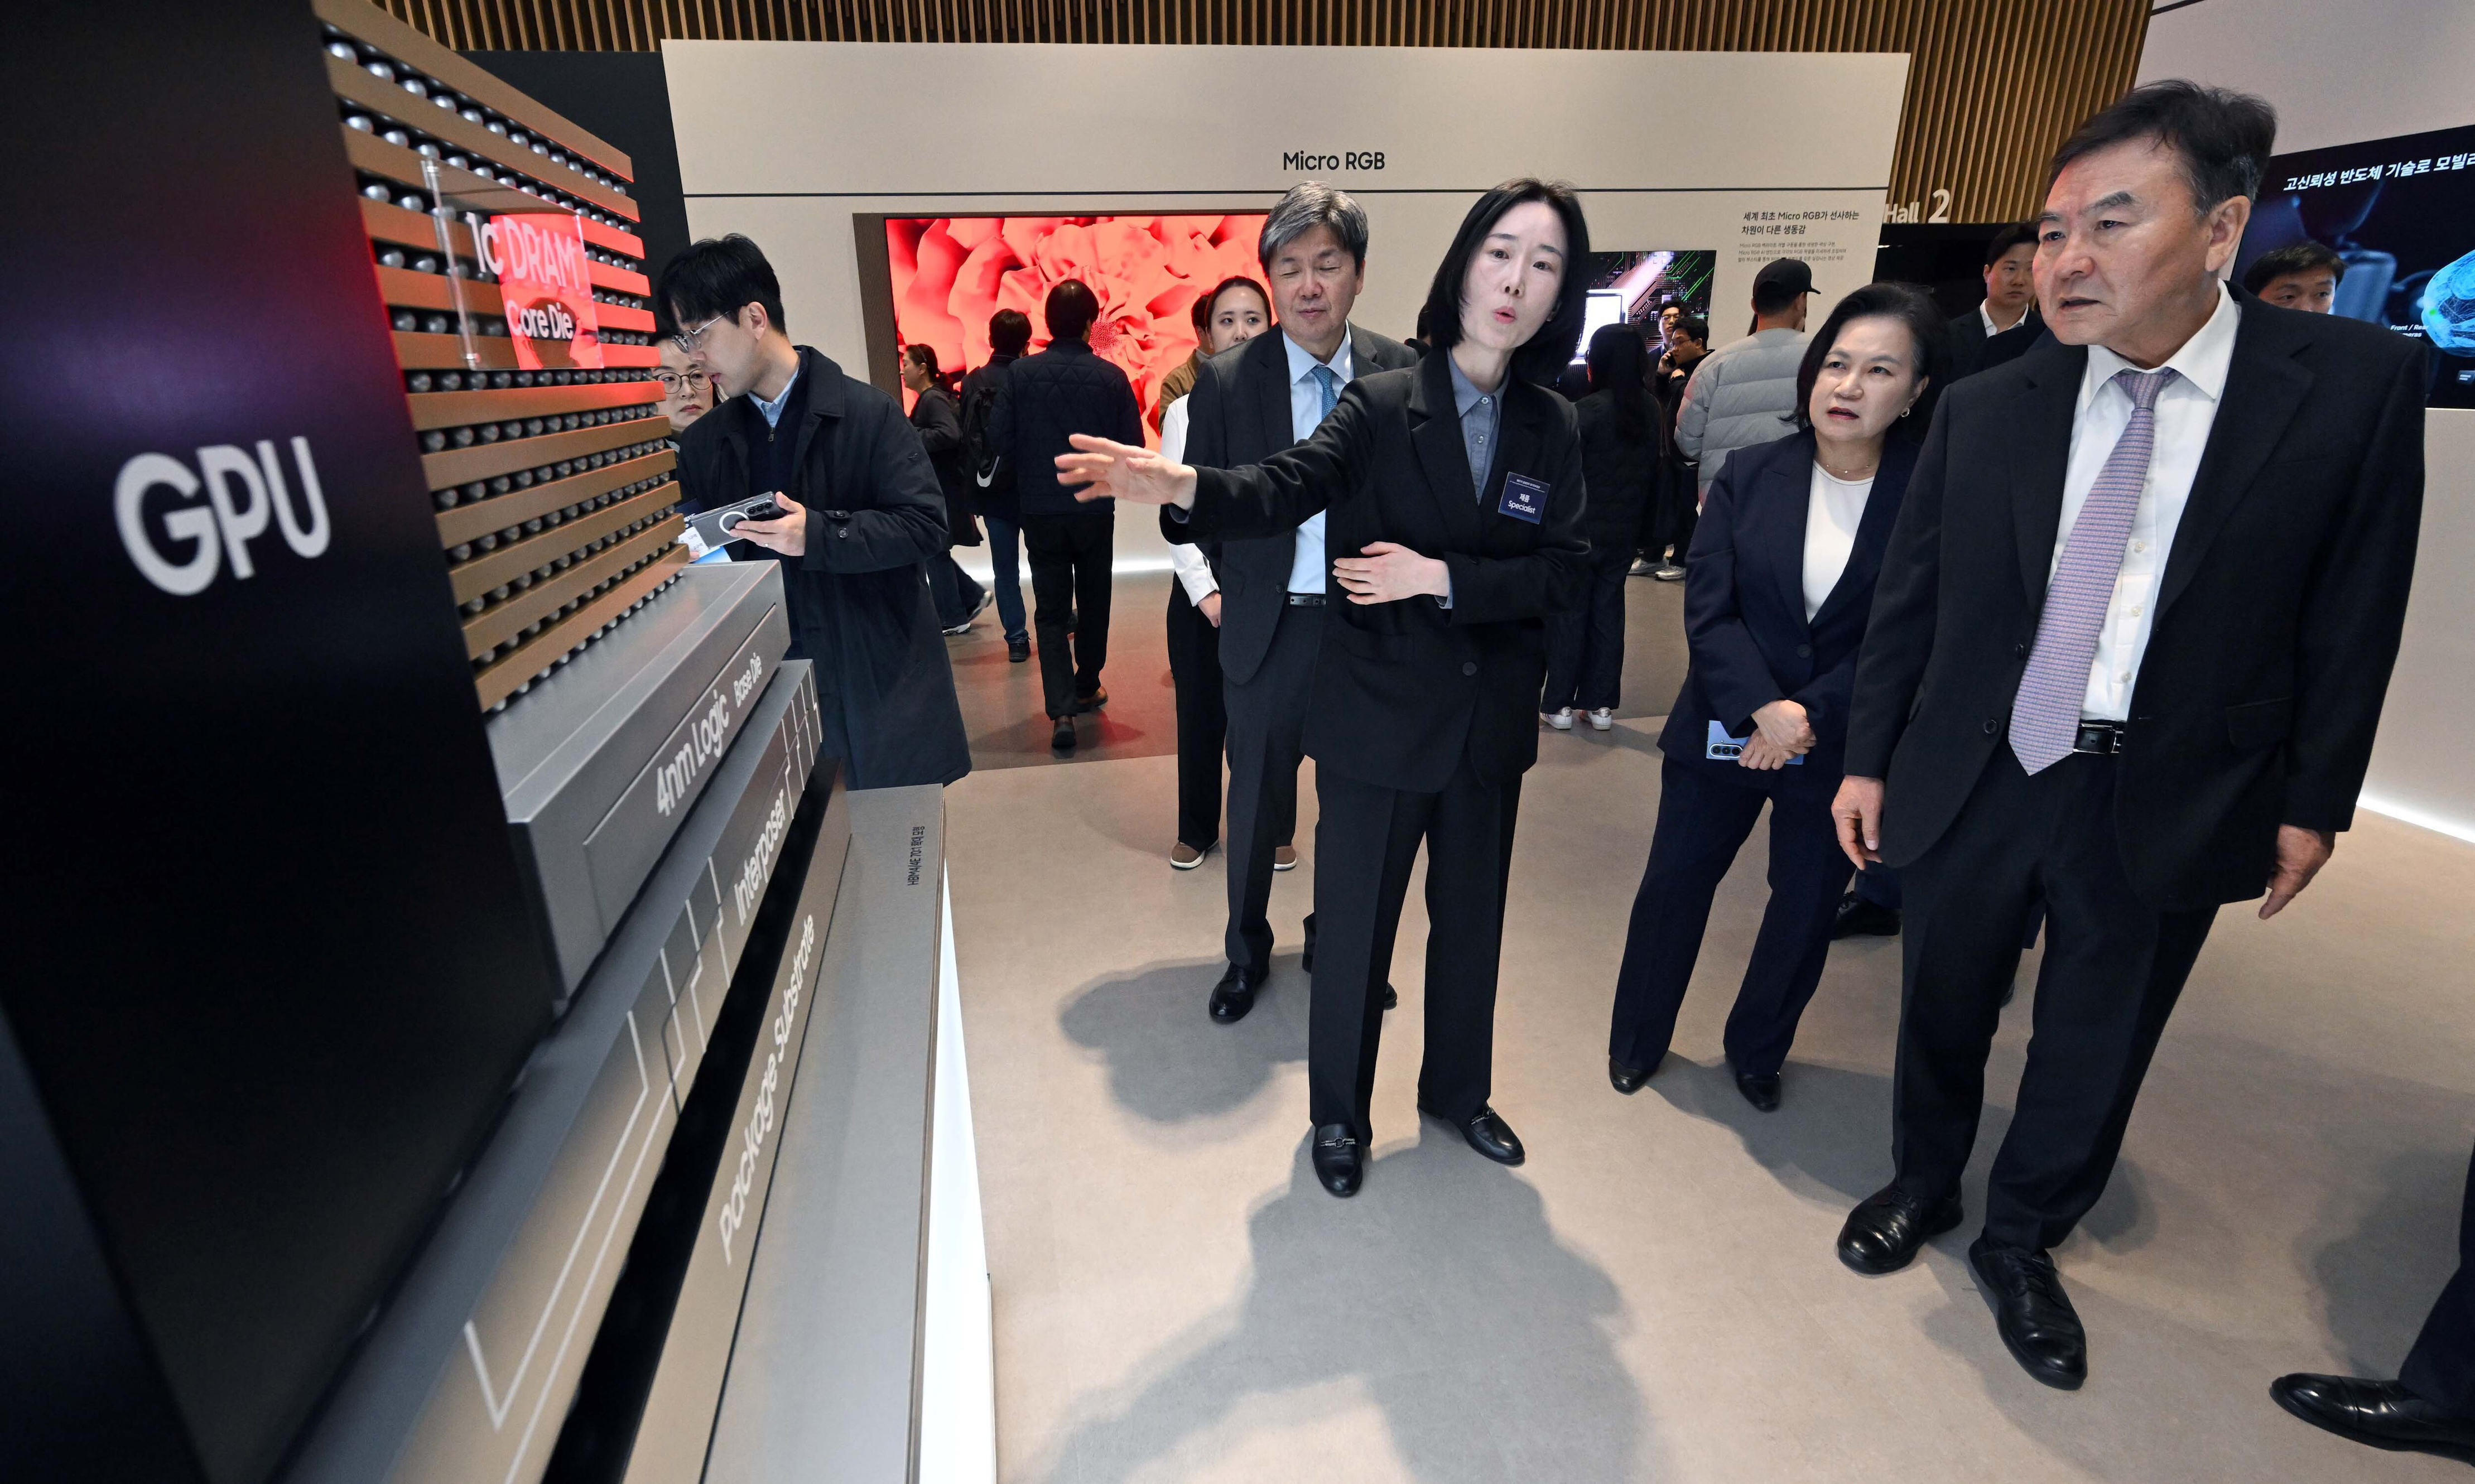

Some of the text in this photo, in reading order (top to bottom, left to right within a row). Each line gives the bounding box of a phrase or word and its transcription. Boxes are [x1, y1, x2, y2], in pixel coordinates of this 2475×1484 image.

[1283, 150, 1385, 170] Micro RGB
[2283, 171, 2337, 191] 고신뢰성
[2340, 165, 2383, 184] 반도체
[2385, 158, 2432, 178] 기술로
[1743, 210, 1860, 221] 세계 최초 Micro RGB가 선사하는
[1882, 189, 1950, 223] Hall 2
[1741, 225, 1806, 235] 차원이 다른 생동감
[503, 216, 580, 290] DRAM
[506, 300, 574, 339] Core Die
[1508, 500, 1535, 514] Specialist
[1519, 493, 1530, 503] 제품
[115, 436, 331, 595] GPU
[656, 652, 762, 817] 4nm Logic Base Die
[911, 836, 924, 846] 확대
[912, 826, 925, 836] 모형
[734, 788, 786, 927] Interposer
[907, 857, 922, 886] HBM4/4E
[719, 914, 815, 1266] Package Substrate
